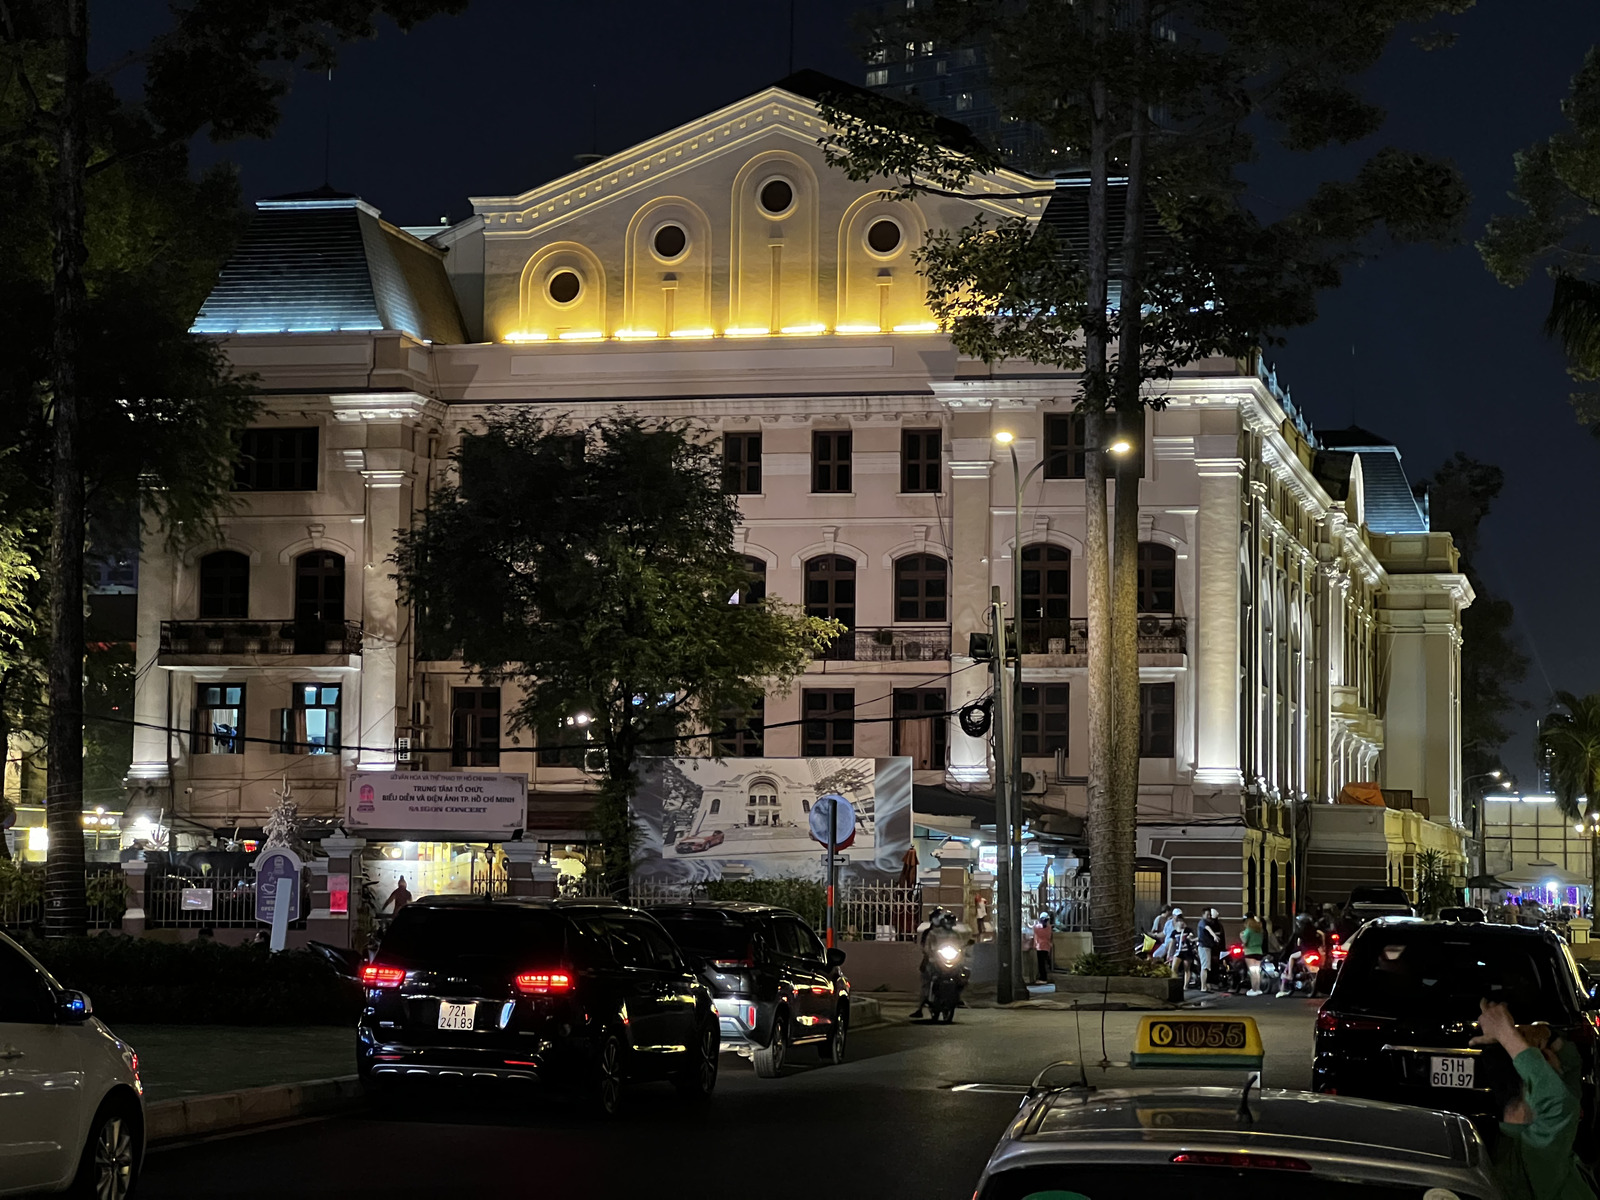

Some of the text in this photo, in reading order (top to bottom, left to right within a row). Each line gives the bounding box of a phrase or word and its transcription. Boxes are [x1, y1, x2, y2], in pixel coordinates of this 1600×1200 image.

[448, 1005, 467, 1017] 72A
[440, 1017, 473, 1029] 241.83
[1173, 1023, 1244, 1047] 1055
[1441, 1058, 1465, 1073] 51H
[1432, 1072, 1473, 1087] 601.97
